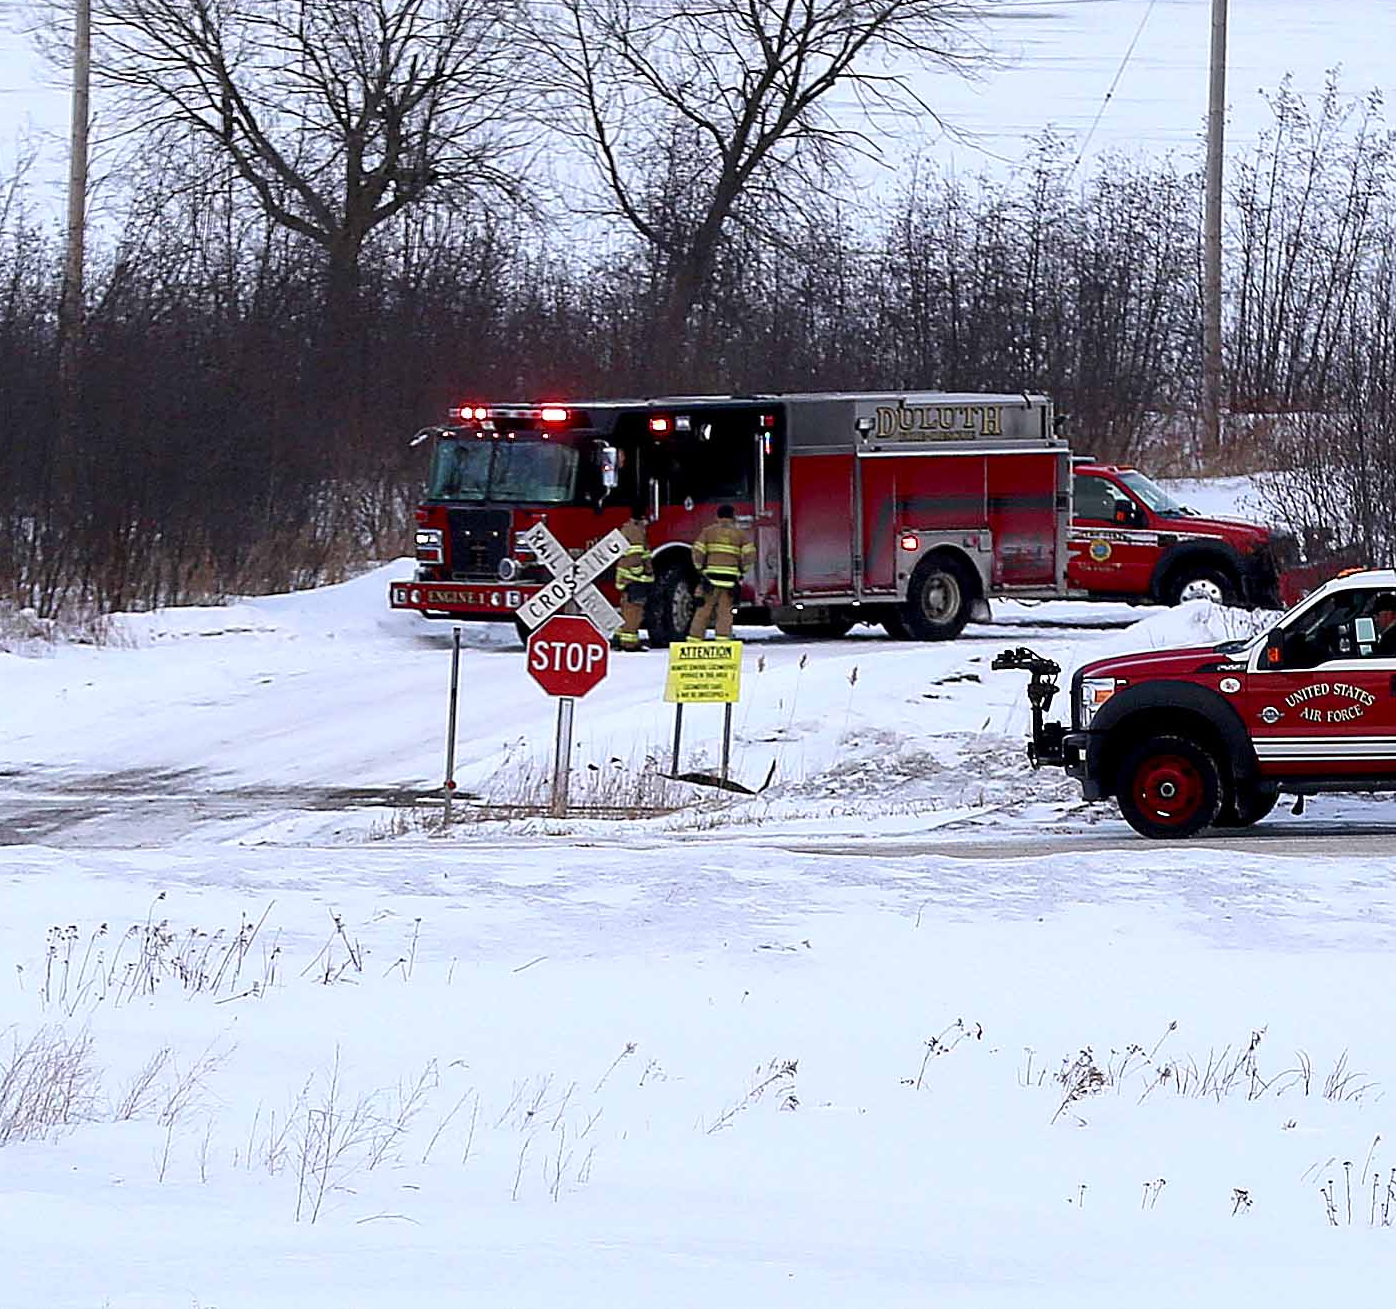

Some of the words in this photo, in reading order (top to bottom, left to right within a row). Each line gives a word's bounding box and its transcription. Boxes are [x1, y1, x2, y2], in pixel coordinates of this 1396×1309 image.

[876, 406, 1003, 438] DULUTH
[428, 591, 475, 604] ENGINE
[531, 641, 604, 673] STOP
[679, 646, 733, 659] ATTENTION
[1285, 683, 1330, 707] UNITED
[1333, 683, 1376, 706] STATES
[1300, 707, 1322, 722] AIR
[1327, 704, 1363, 722] FORCE
